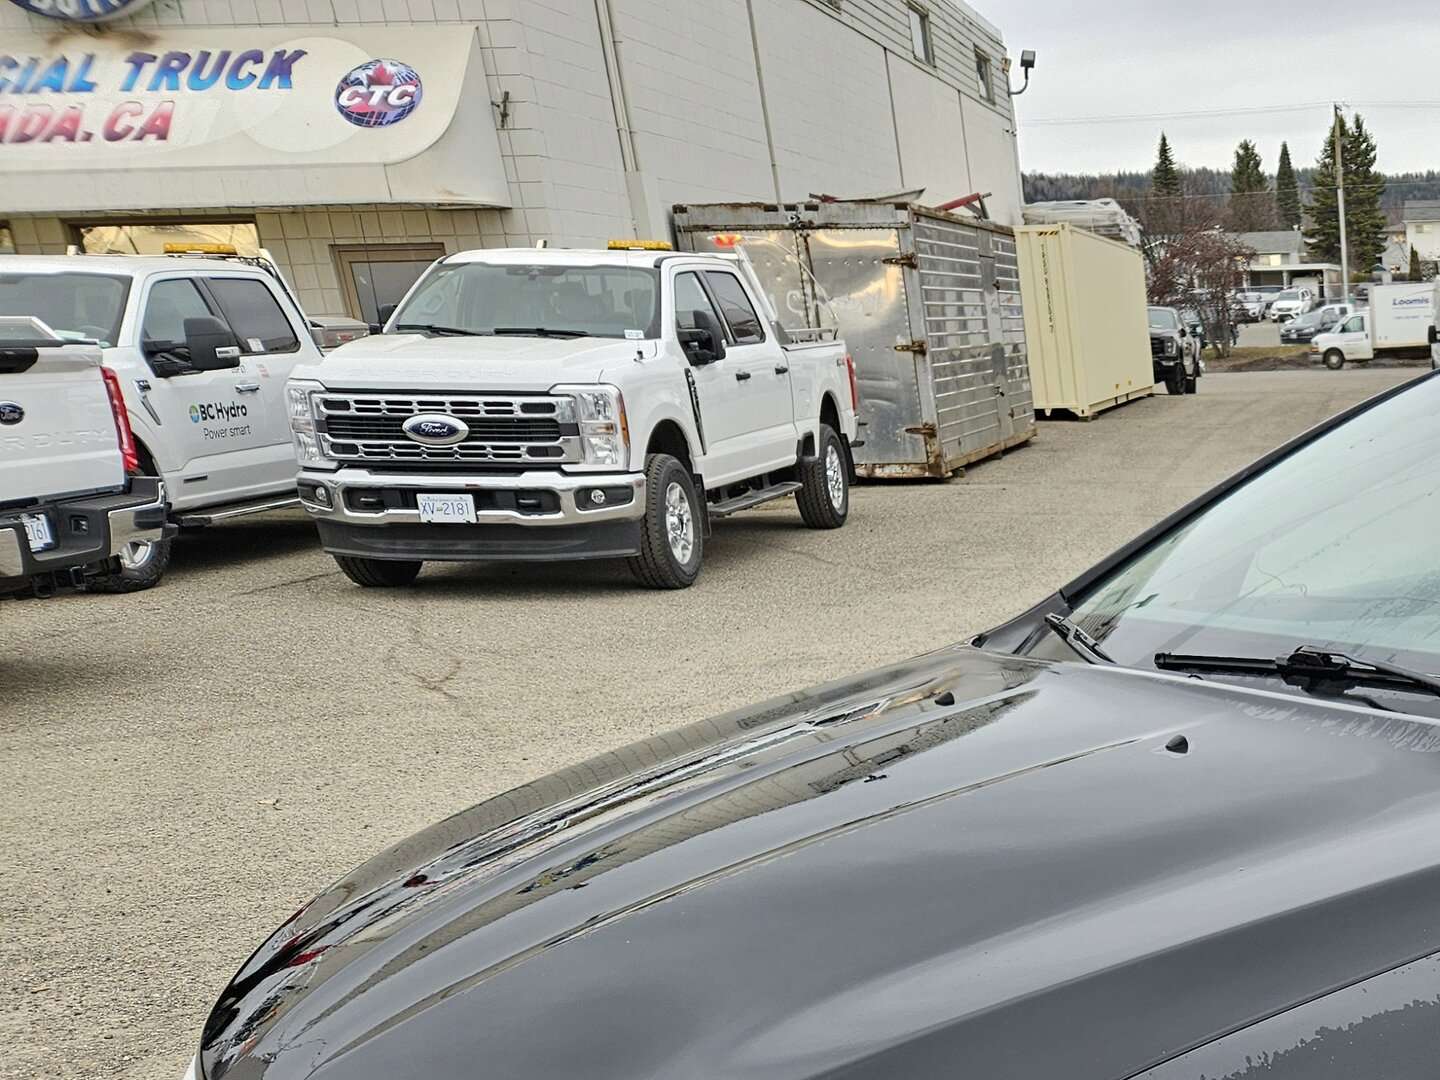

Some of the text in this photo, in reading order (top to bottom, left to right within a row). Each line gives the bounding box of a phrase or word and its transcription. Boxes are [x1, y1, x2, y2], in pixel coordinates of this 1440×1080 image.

[118, 49, 308, 92] TRUCK
[338, 84, 418, 107] CTC
[199, 401, 248, 422] BC Hydro
[203, 424, 252, 440] Power smart
